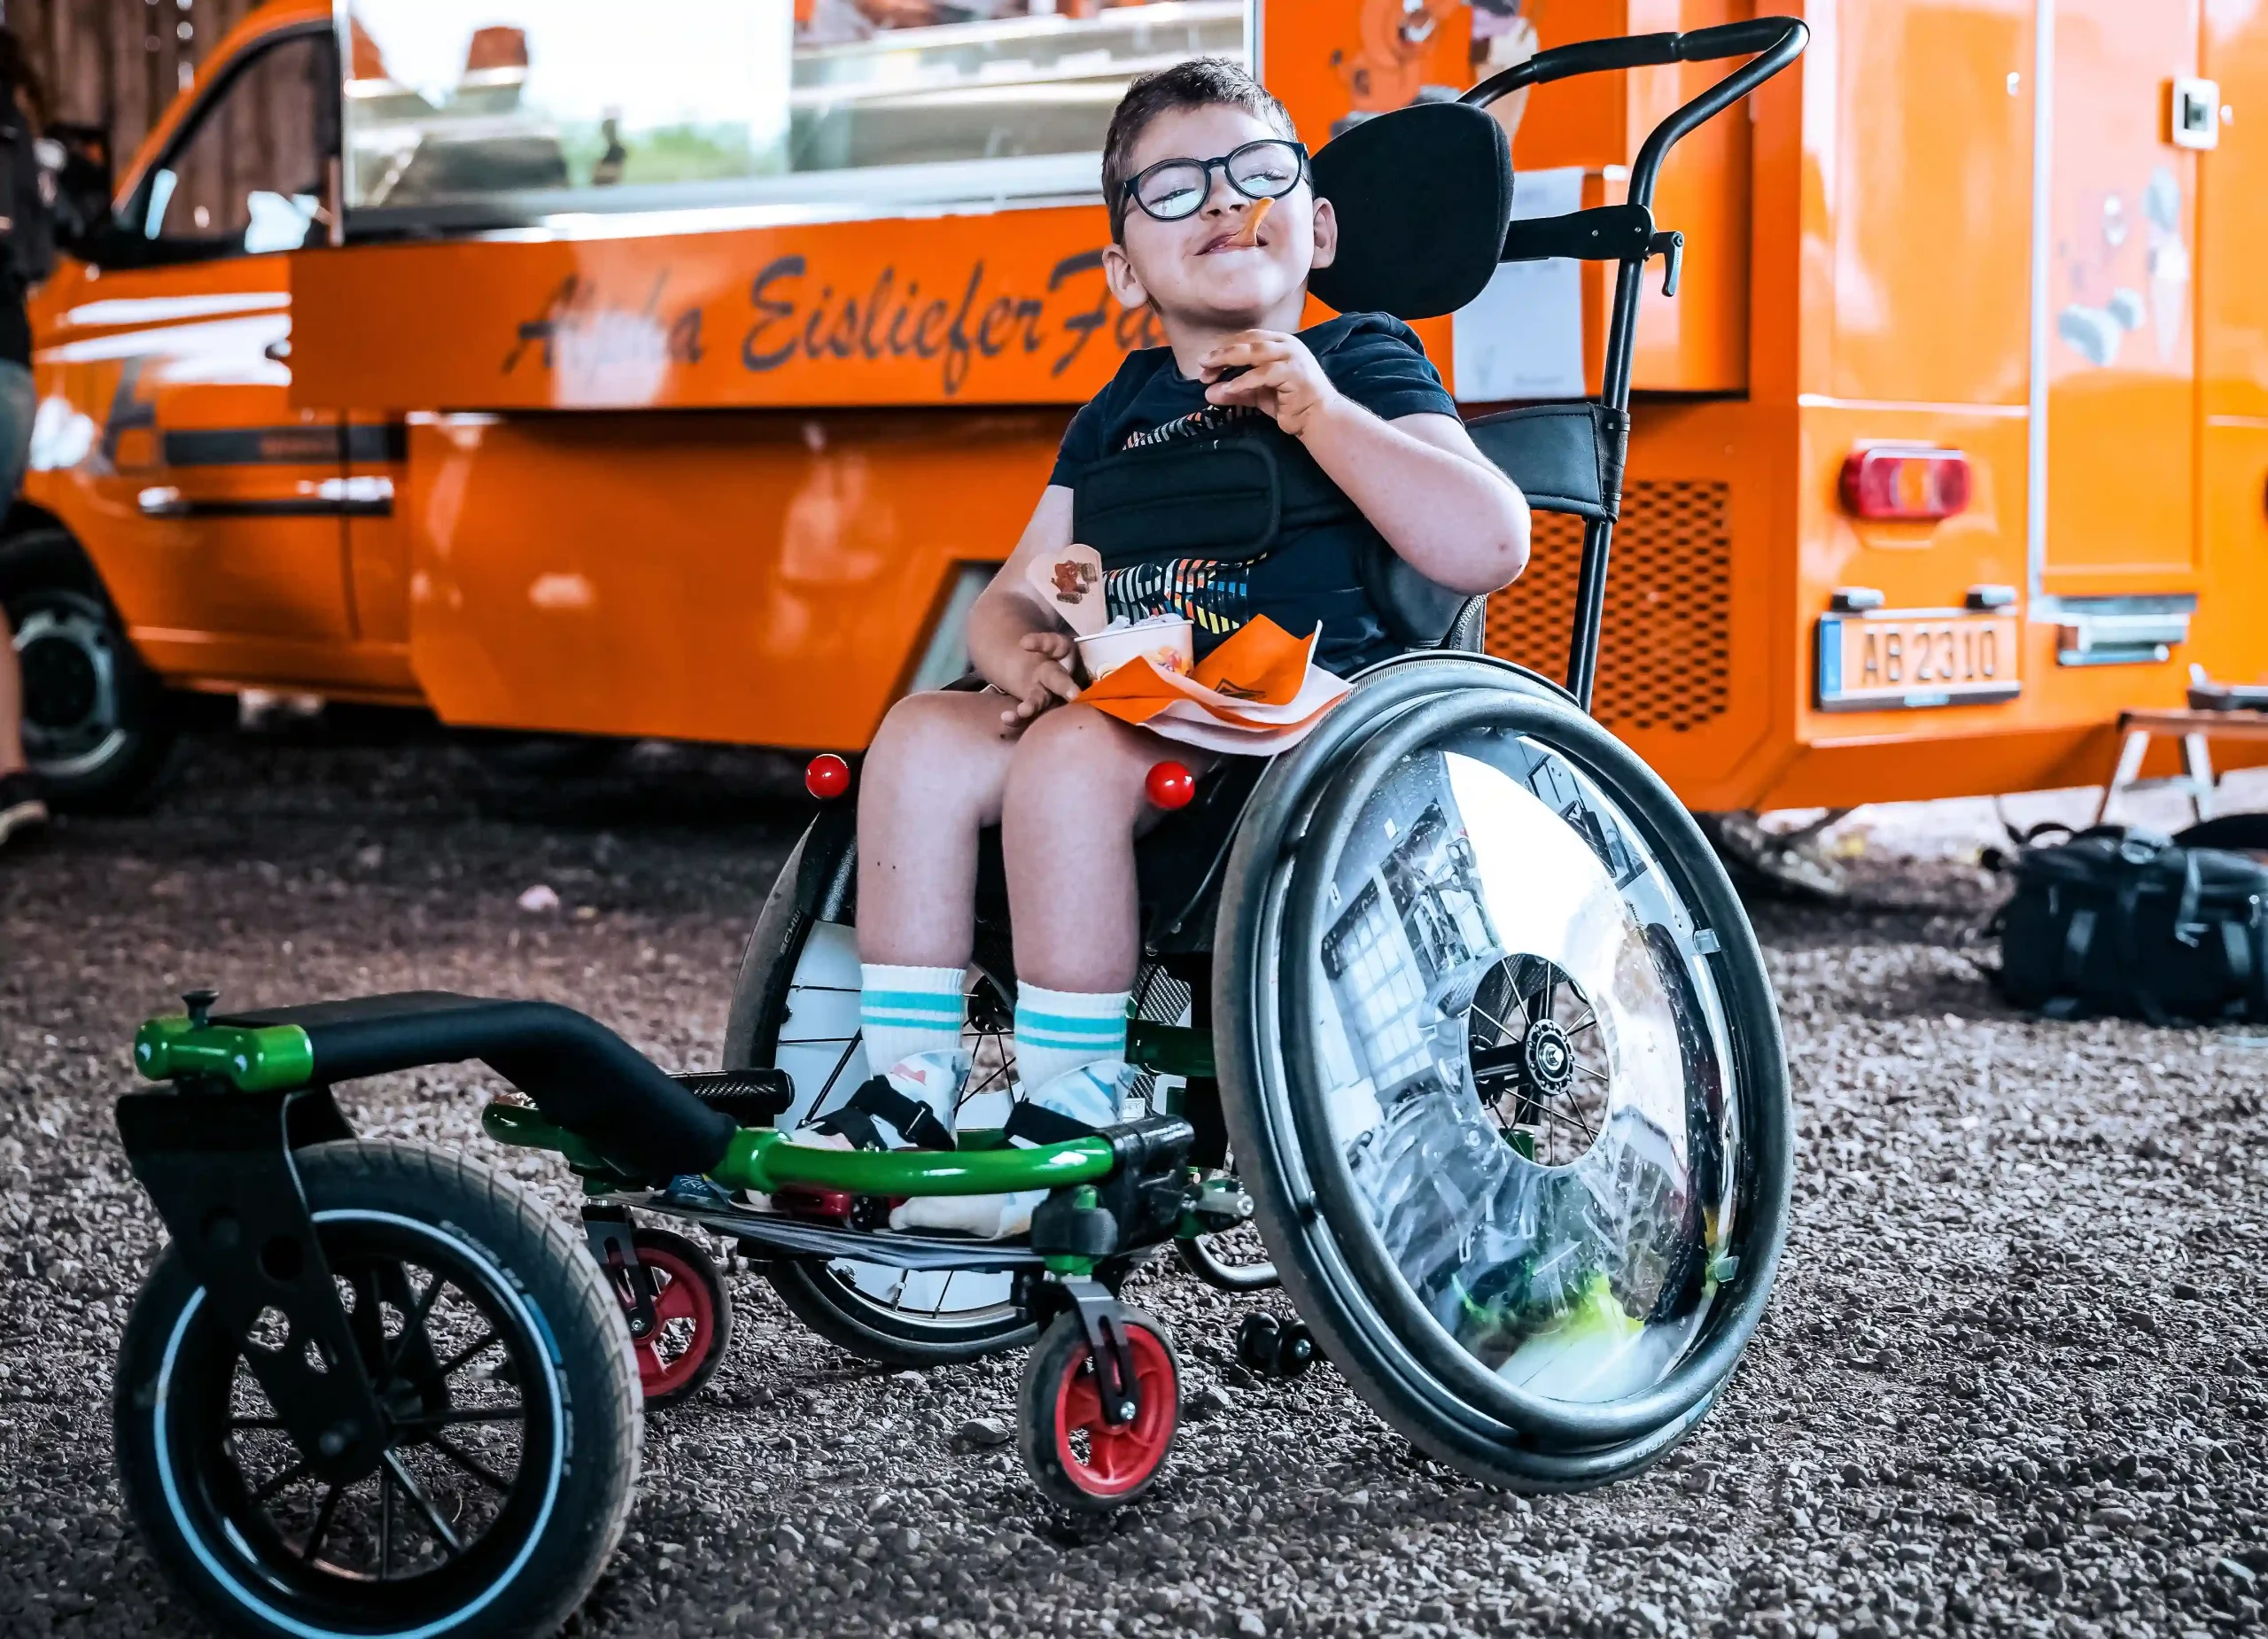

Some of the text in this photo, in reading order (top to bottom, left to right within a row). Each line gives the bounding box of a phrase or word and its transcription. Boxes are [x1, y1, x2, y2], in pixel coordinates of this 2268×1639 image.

[1862, 619, 1997, 685] AB 2310
[780, 908, 801, 955] SCHW
